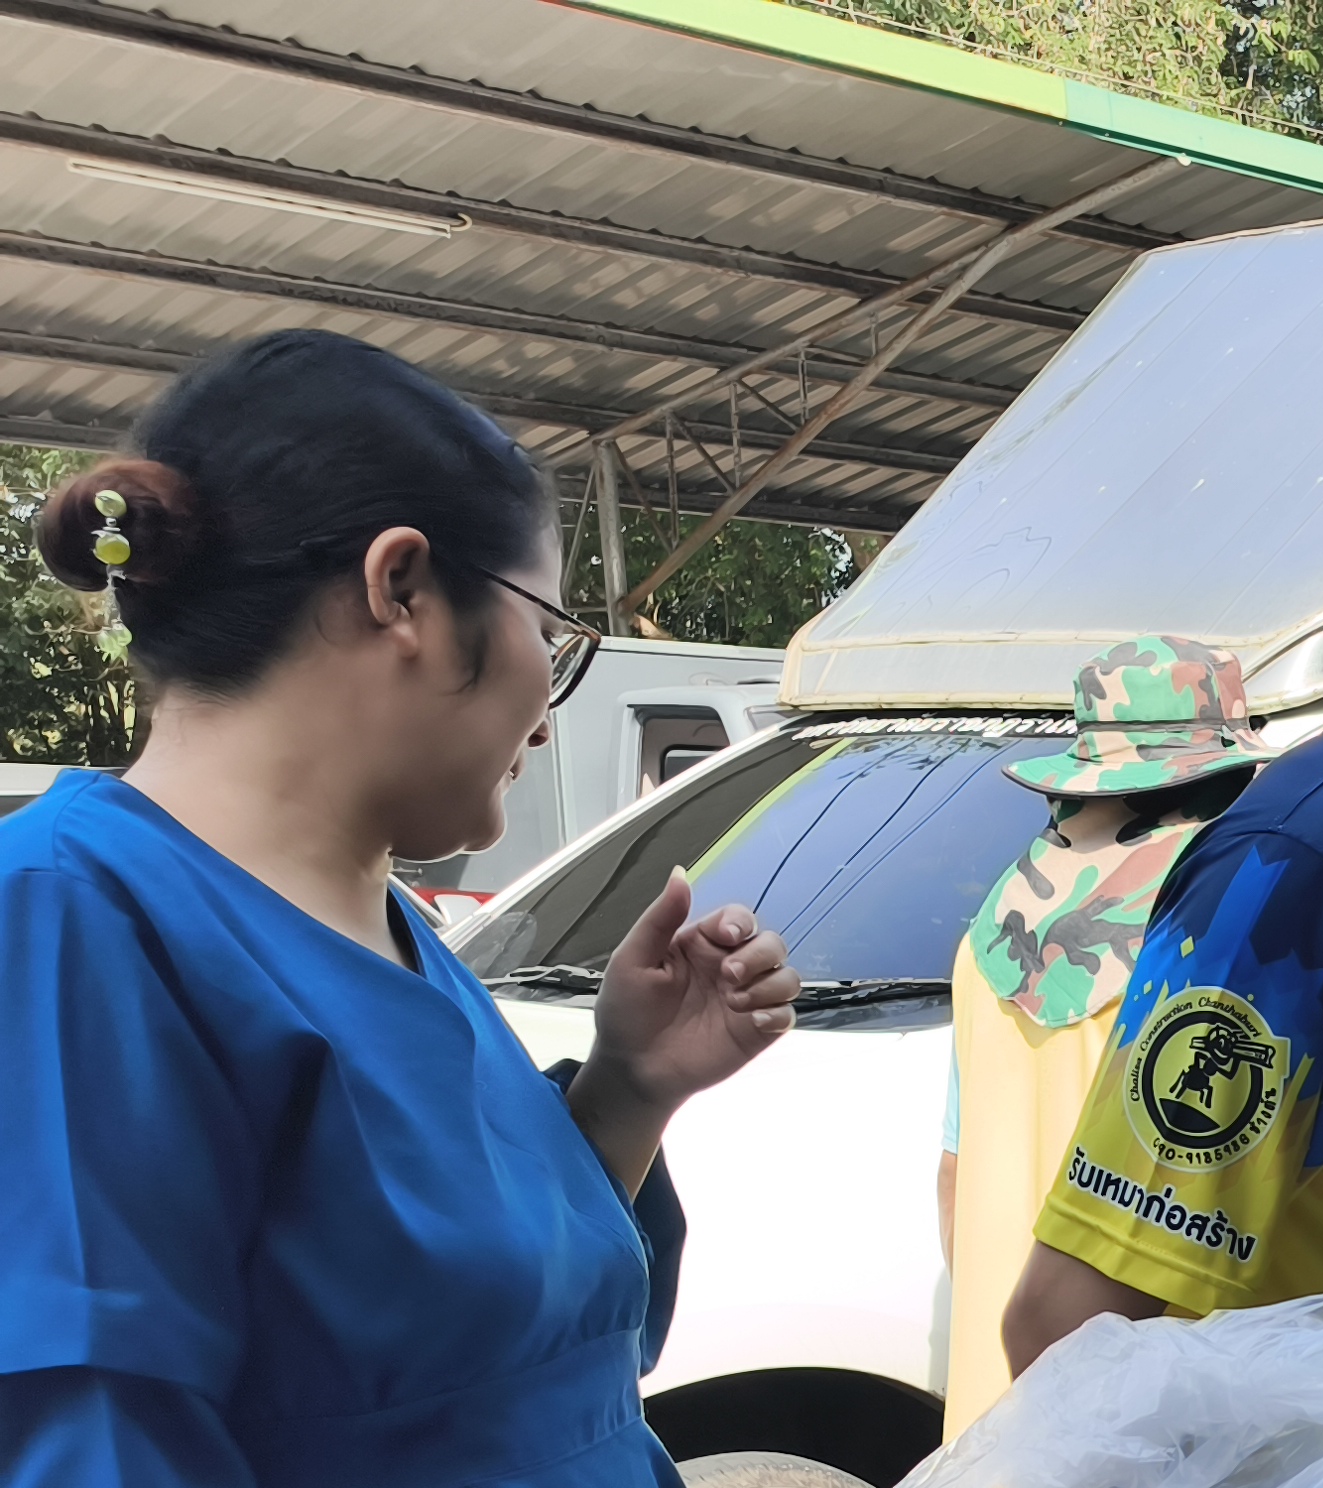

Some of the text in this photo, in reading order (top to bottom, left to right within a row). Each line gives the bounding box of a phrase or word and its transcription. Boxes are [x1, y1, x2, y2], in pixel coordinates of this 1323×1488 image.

[1140, 1001, 1193, 1052] Construction
[1198, 996, 1263, 1038] Chanthaburi
[1068, 1146, 1257, 1261] รับเหมาก่อสร้าง
